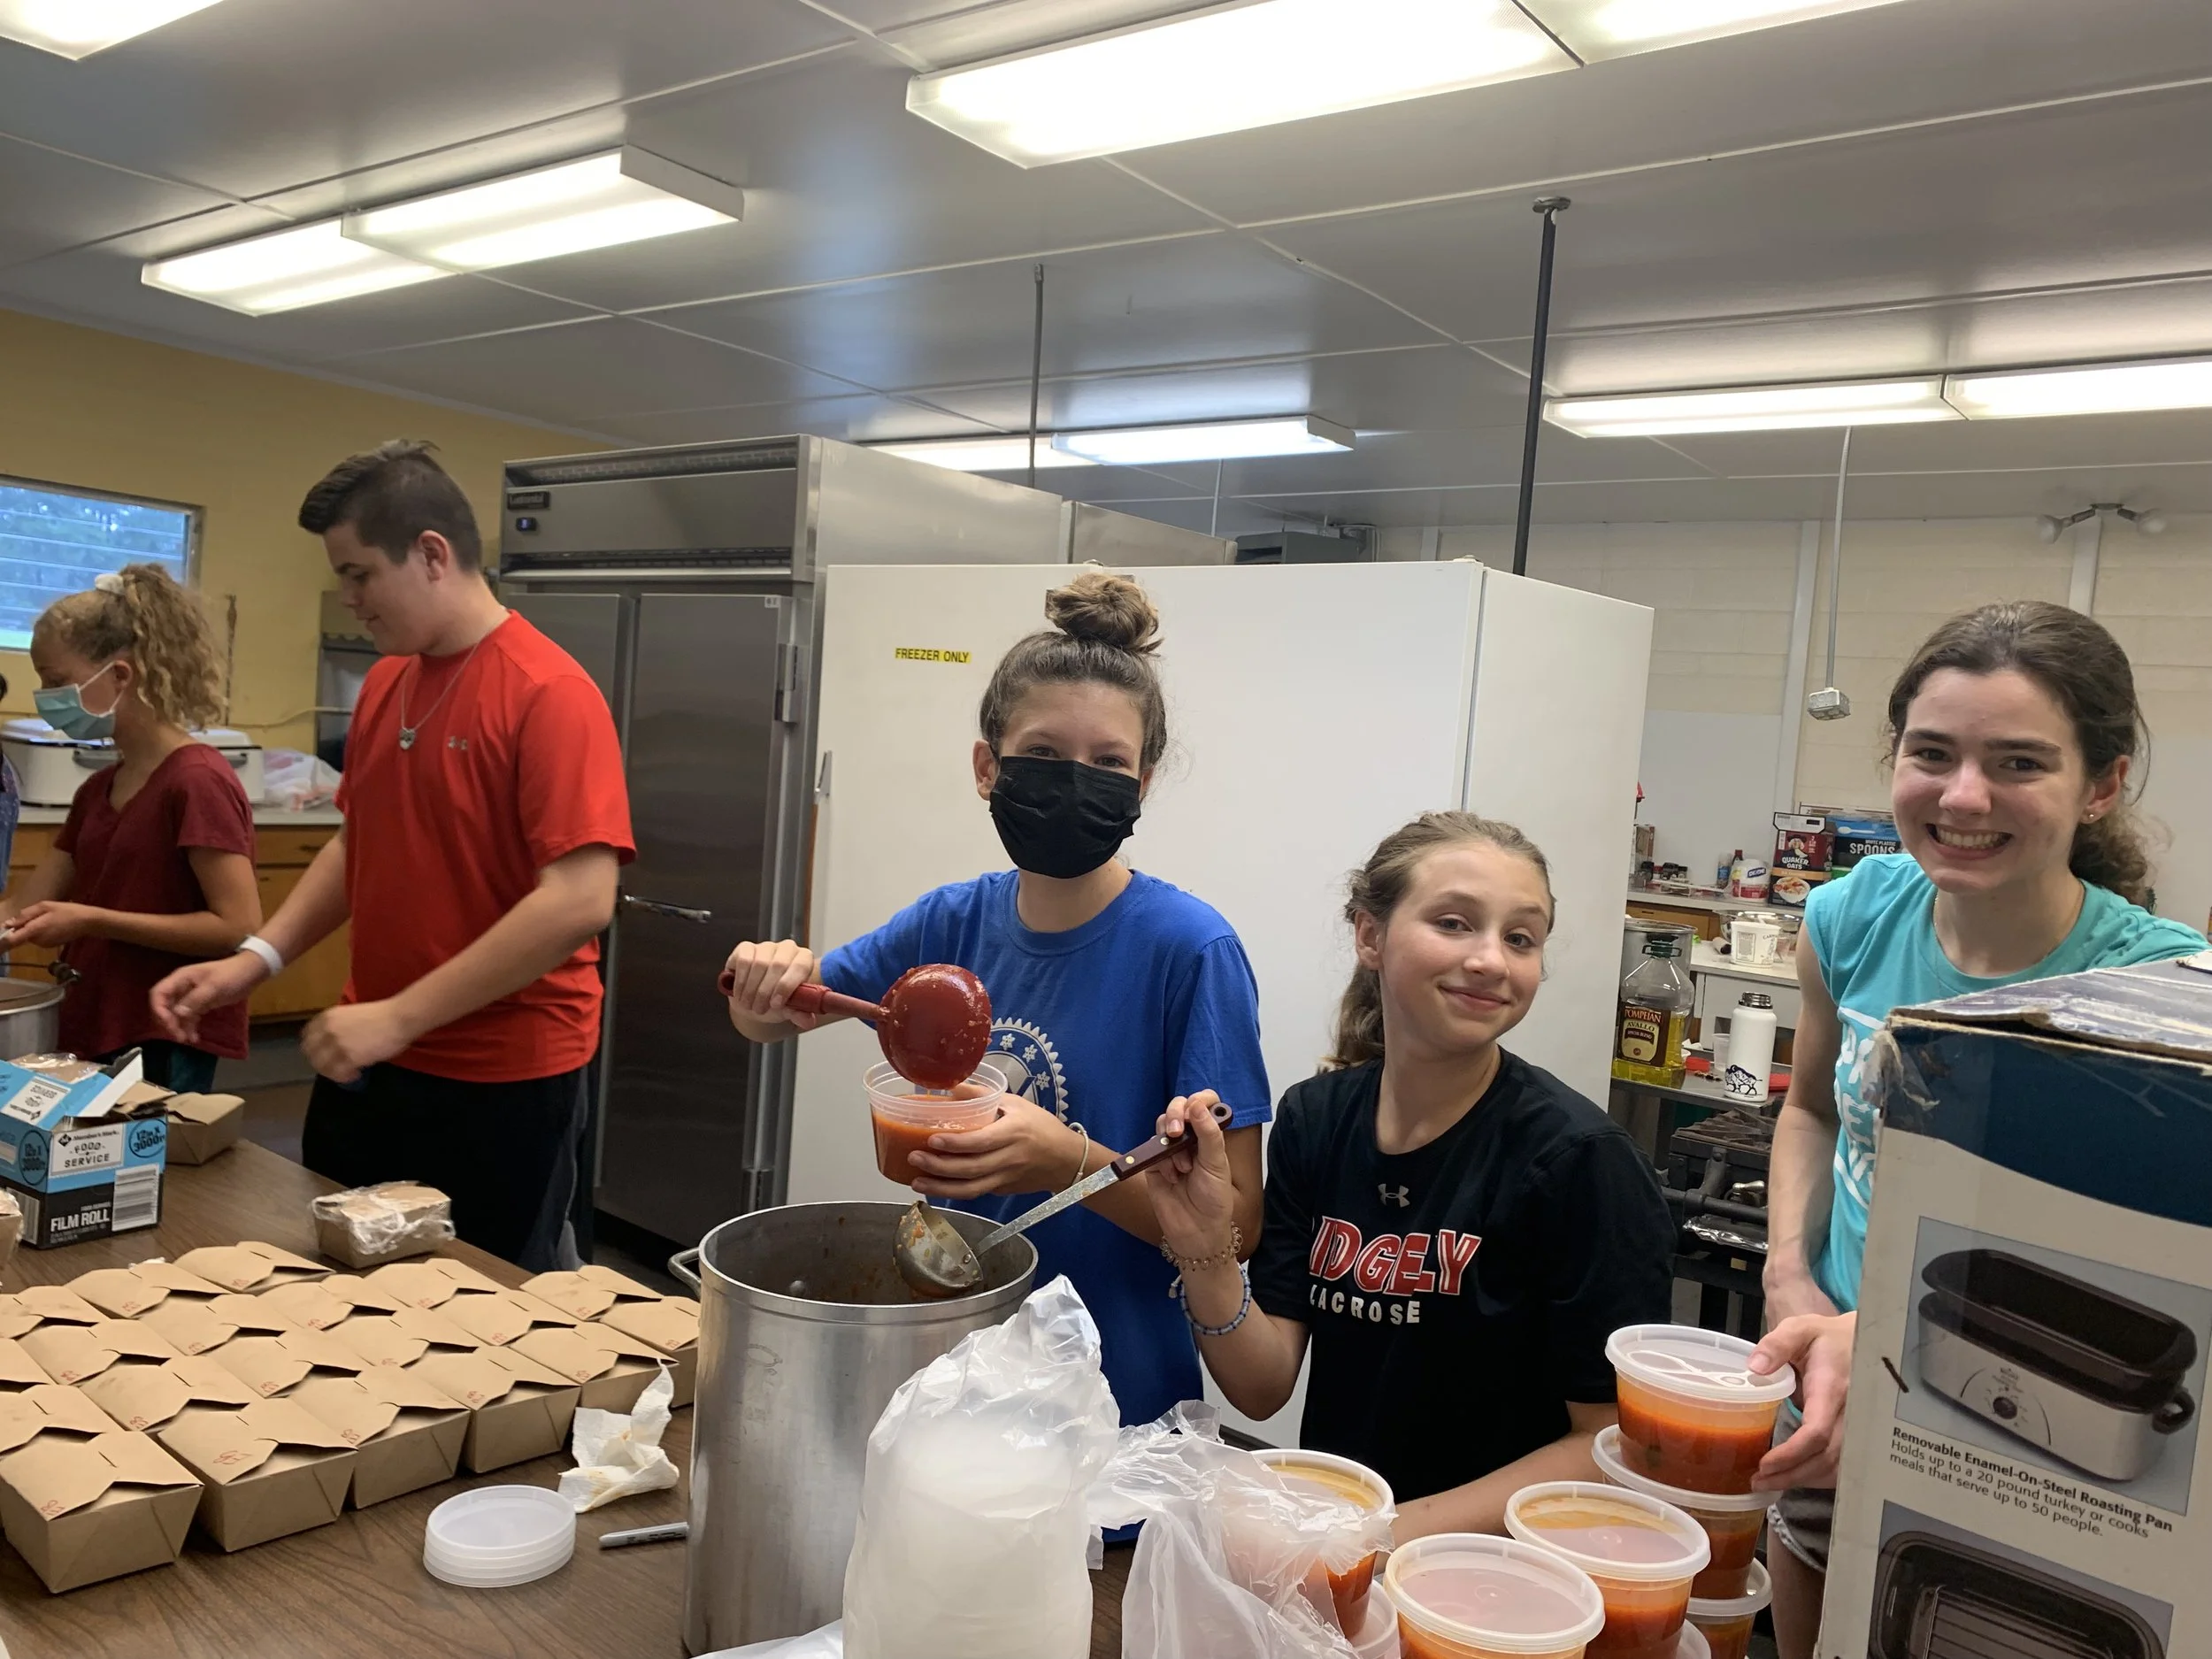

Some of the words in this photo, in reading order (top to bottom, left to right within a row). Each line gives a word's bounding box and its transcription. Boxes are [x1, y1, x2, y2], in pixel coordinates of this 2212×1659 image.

[895, 648, 940, 662] FREEZER
[943, 650, 970, 664] ONLY
[1849, 842, 1895, 855] SPOONS
[1781, 856, 1809, 865] QUAKER
[1624, 1009, 1662, 1023] POMPEIAN
[1626, 1022, 1655, 1032] AVALLO
[64, 1153, 111, 1168] SERVICE
[50, 1213, 80, 1233] FILM
[81, 1208, 110, 1226] ROLL
[1893, 1426, 1962, 1460] Removable
[1964, 1452, 2077, 1499] Enamel-On-Steel
[2080, 1491, 2142, 1525] Roasting
[2146, 1513, 2173, 1532] Pan
[1890, 1454, 1925, 1474] meals
[1928, 1466, 1953, 1484] that
[1956, 1478, 1989, 1496] serve
[1993, 1491, 2010, 1505] up
[2014, 1497, 2028, 1509] to
[2032, 1502, 2049, 1517] 50
[2053, 1511, 2104, 1536] people.
[1891, 1439, 1925, 1460] Holds
[1929, 1455, 1945, 1468] up
[1949, 1461, 1962, 1473] to
[1965, 1468, 1973, 1477] a
[1977, 1470, 1993, 1484] 20
[1997, 1479, 2040, 1501] pound
[2044, 1493, 2086, 1518] turkey
[2090, 1510, 2105, 1522] or
[2108, 1517, 2149, 1539] cooks
